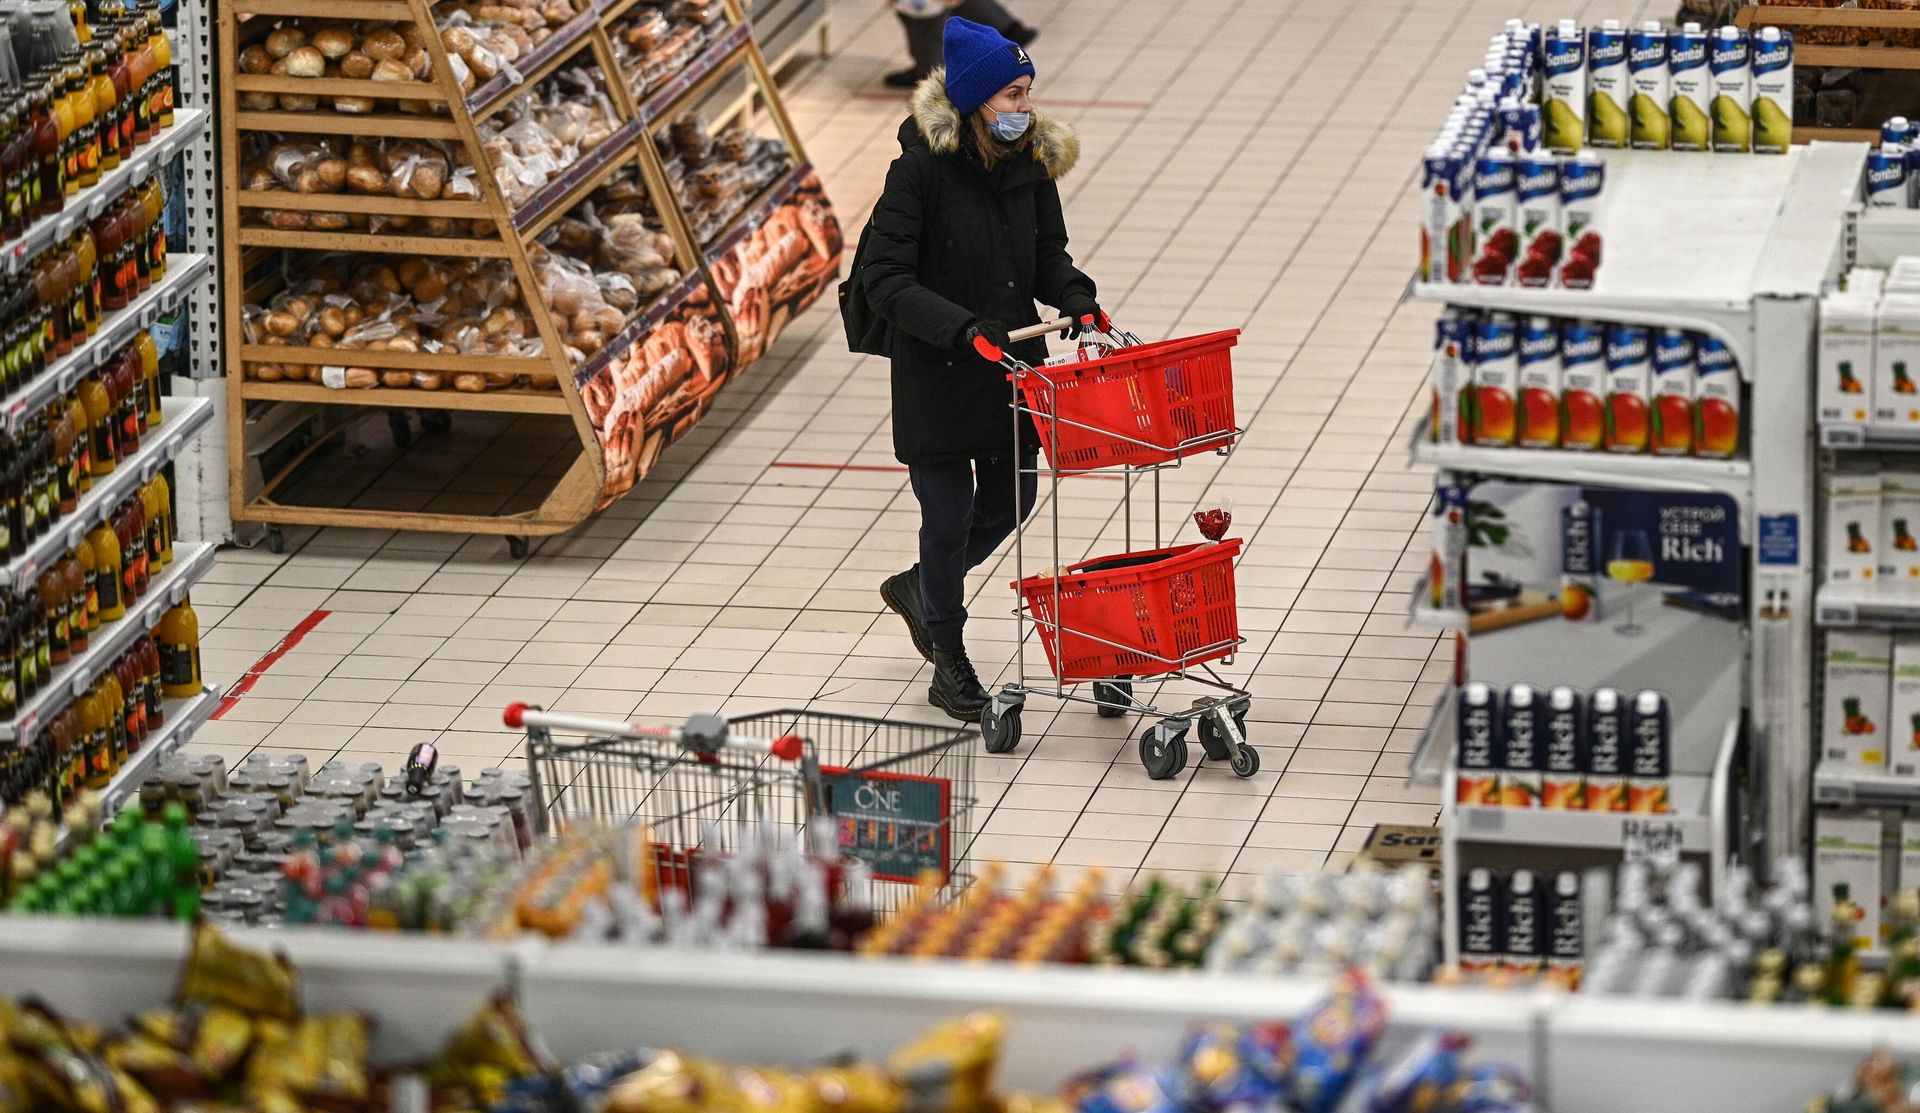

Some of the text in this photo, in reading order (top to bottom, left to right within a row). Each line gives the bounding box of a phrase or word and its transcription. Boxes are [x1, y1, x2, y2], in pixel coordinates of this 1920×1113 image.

[1659, 505, 1725, 523] УСТРОЙ
[1659, 521, 1702, 535] СЕБЕ
[1566, 520, 1590, 572] Rich
[1661, 537, 1723, 563] Rich
[1464, 708, 1490, 767] Rich
[1506, 709, 1534, 769] Rich
[1548, 712, 1575, 771] Rich
[1591, 715, 1619, 773] Rich
[1633, 717, 1661, 775] Rich
[854, 784, 902, 812] ONE
[1465, 894, 1492, 951] Rich
[1507, 897, 1535, 953] Rich
[1553, 899, 1581, 955] Rich
